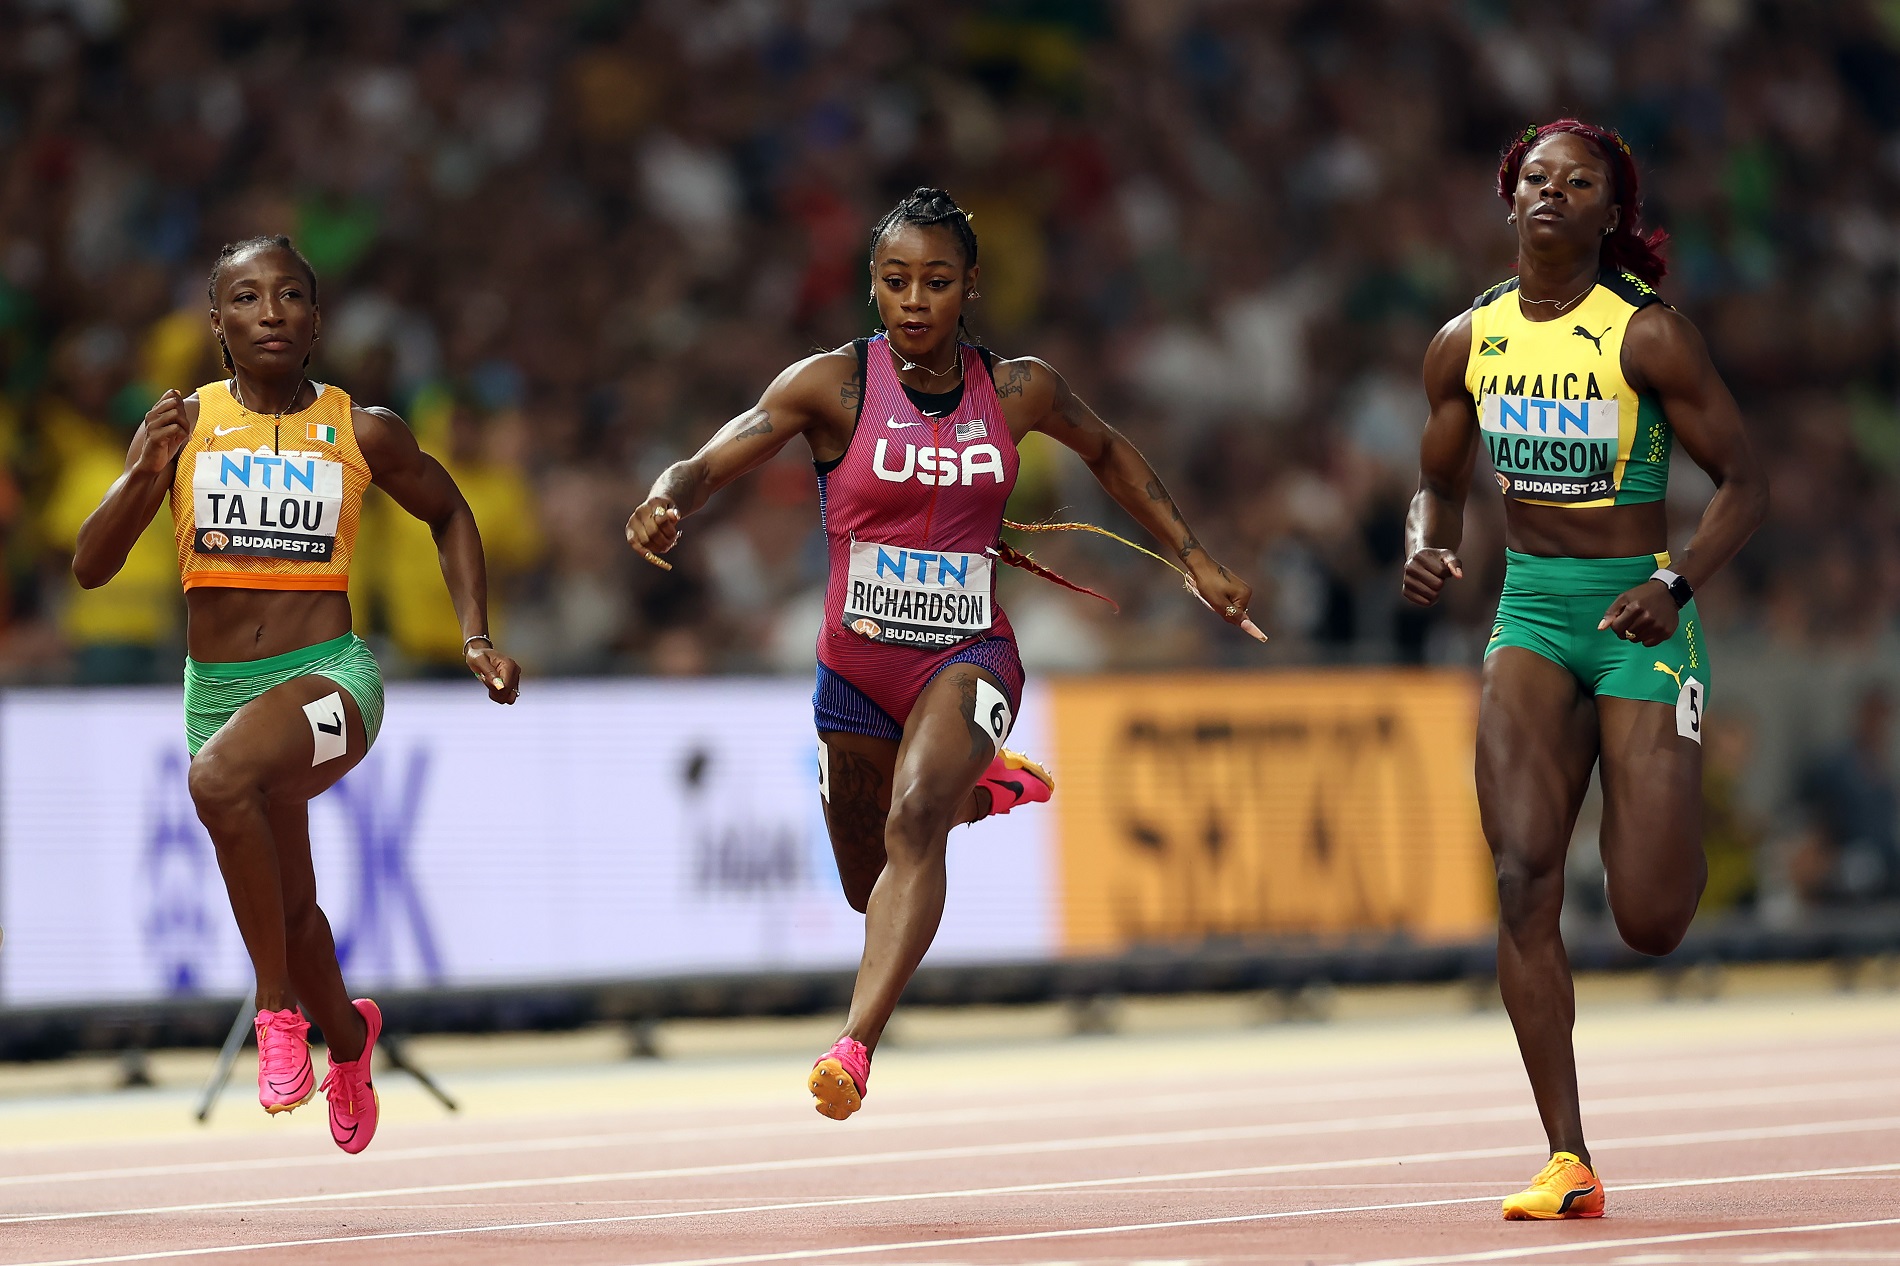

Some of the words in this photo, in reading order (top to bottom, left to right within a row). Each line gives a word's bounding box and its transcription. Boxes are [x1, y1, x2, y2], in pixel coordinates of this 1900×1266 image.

[1476, 372, 1603, 406] JAMAICA
[1500, 397, 1589, 436] NTN
[220, 453, 315, 493] NTN
[872, 438, 1005, 487] USA
[1514, 480, 1590, 495] BUDAPEST
[1590, 480, 1608, 493] 23
[207, 493, 248, 526] TA
[259, 496, 323, 531] LOU
[232, 535, 310, 553] BUDAPEST
[311, 542, 326, 554] 23
[876, 546, 969, 589] NTN
[851, 580, 984, 625] RICHARDSON
[884, 628, 964, 645] BUDAPEST
[317, 711, 342, 736] 7
[990, 702, 1006, 738] 6
[1690, 687, 1699, 733] 5
